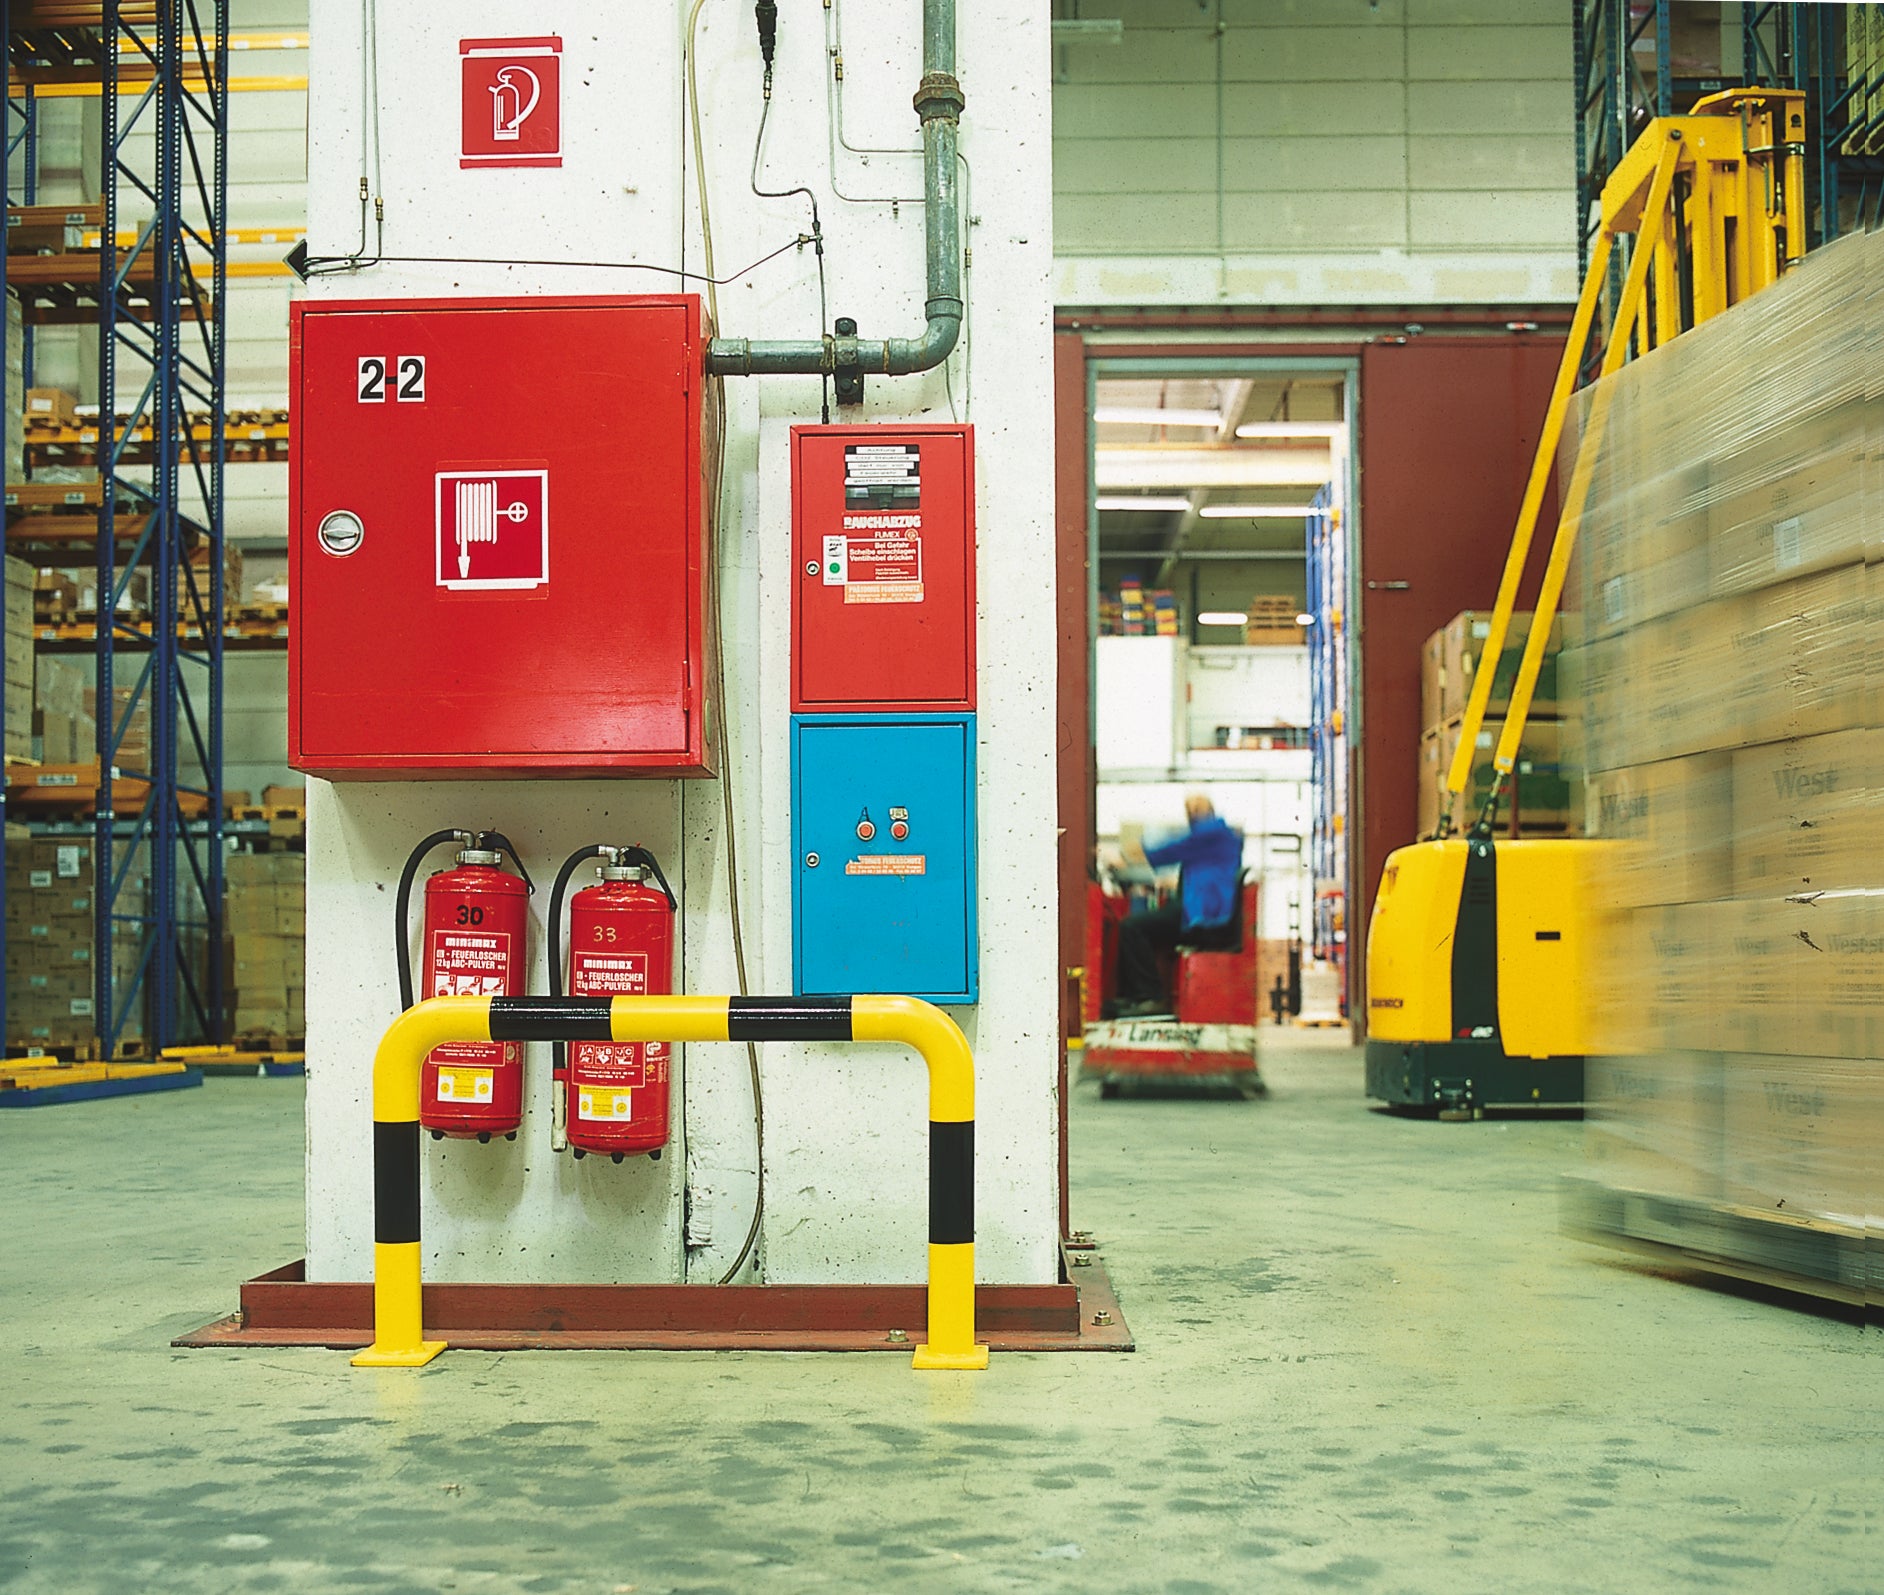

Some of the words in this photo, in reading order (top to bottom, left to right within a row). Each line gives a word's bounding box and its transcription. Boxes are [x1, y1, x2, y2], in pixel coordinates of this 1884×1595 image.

[360, 358, 423, 399] 2-2
[843, 515, 922, 529] RAUCHABZUG
[886, 542, 910, 550] Gefahr
[1772, 763, 1840, 800] West
[456, 904, 484, 925] 30
[445, 937, 497, 949] minimax
[593, 925, 617, 943] 33
[583, 959, 633, 970] minimax
[1763, 1080, 1826, 1117] West
